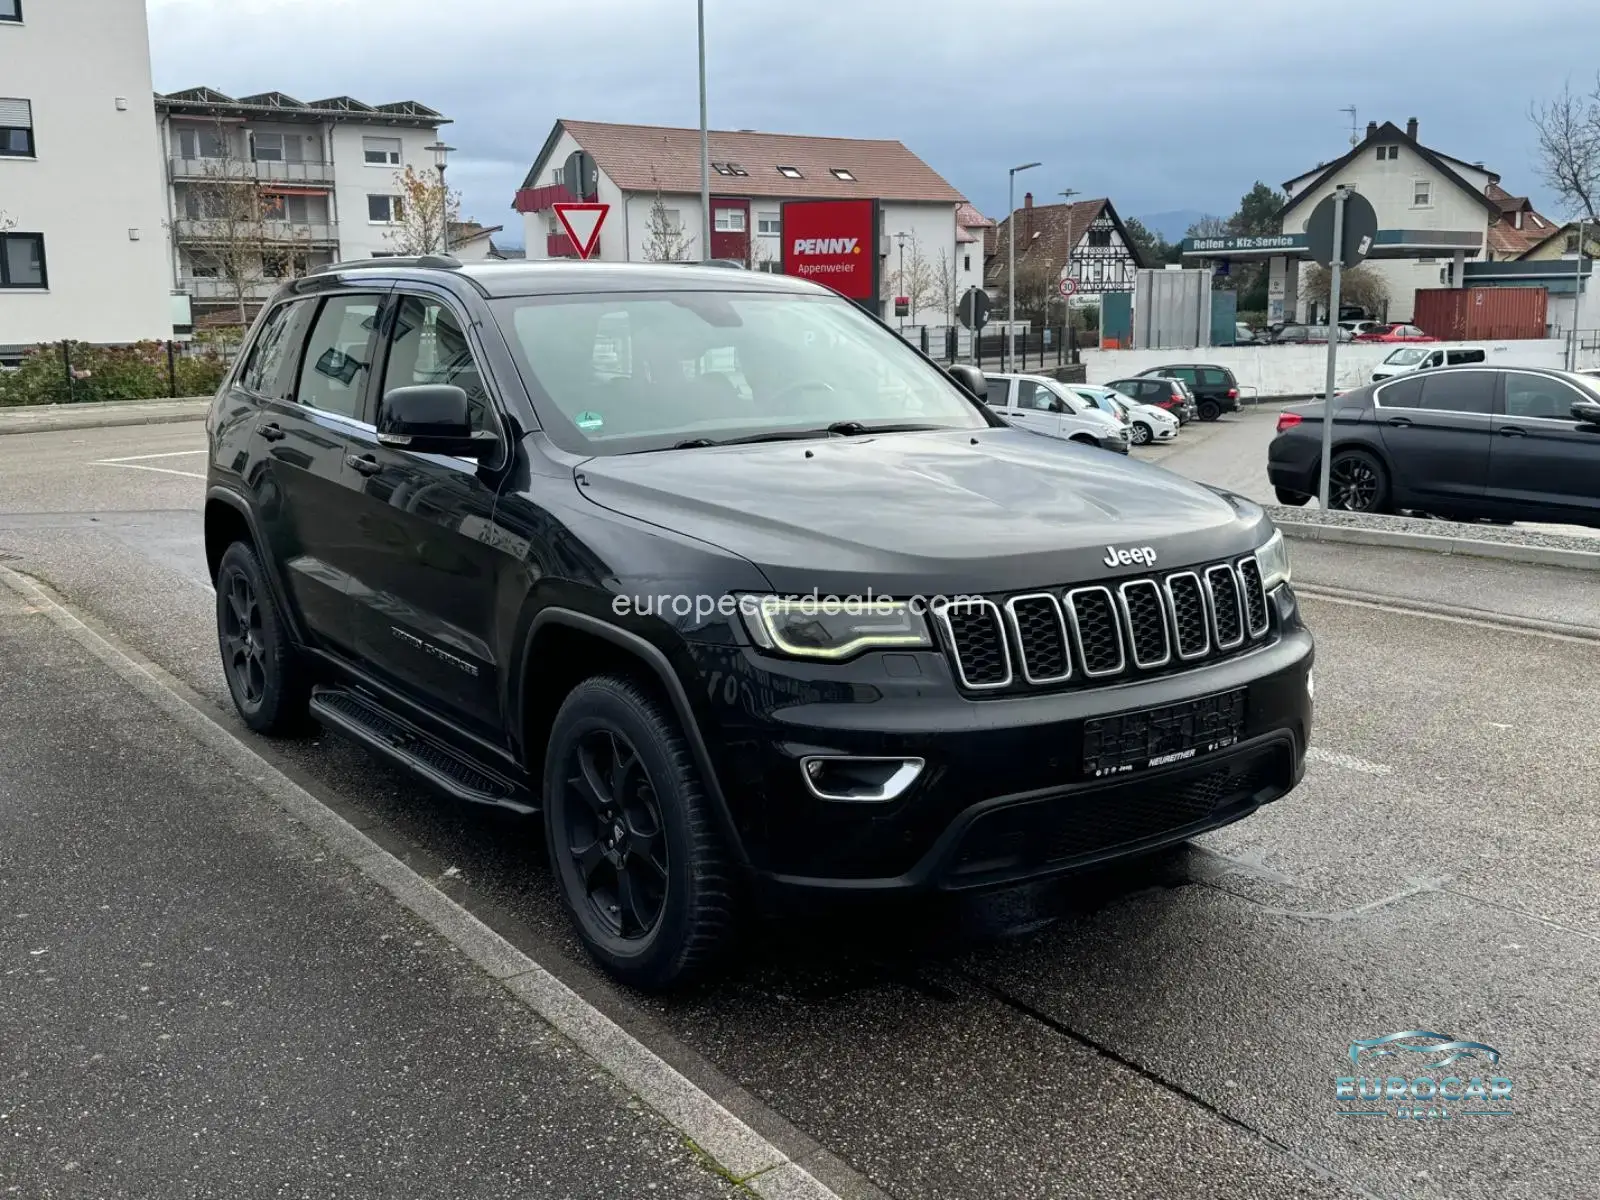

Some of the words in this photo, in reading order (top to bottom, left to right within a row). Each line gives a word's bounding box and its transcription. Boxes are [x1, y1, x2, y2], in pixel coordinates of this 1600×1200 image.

[1193, 239, 1224, 249] Reifen
[1236, 236, 1293, 247] Kfz-Service
[798, 263, 855, 275] Appenweier
[1063, 283, 1073, 291] 30
[1103, 545, 1157, 567] Jeep
[1148, 749, 1196, 767] NEUREITHER
